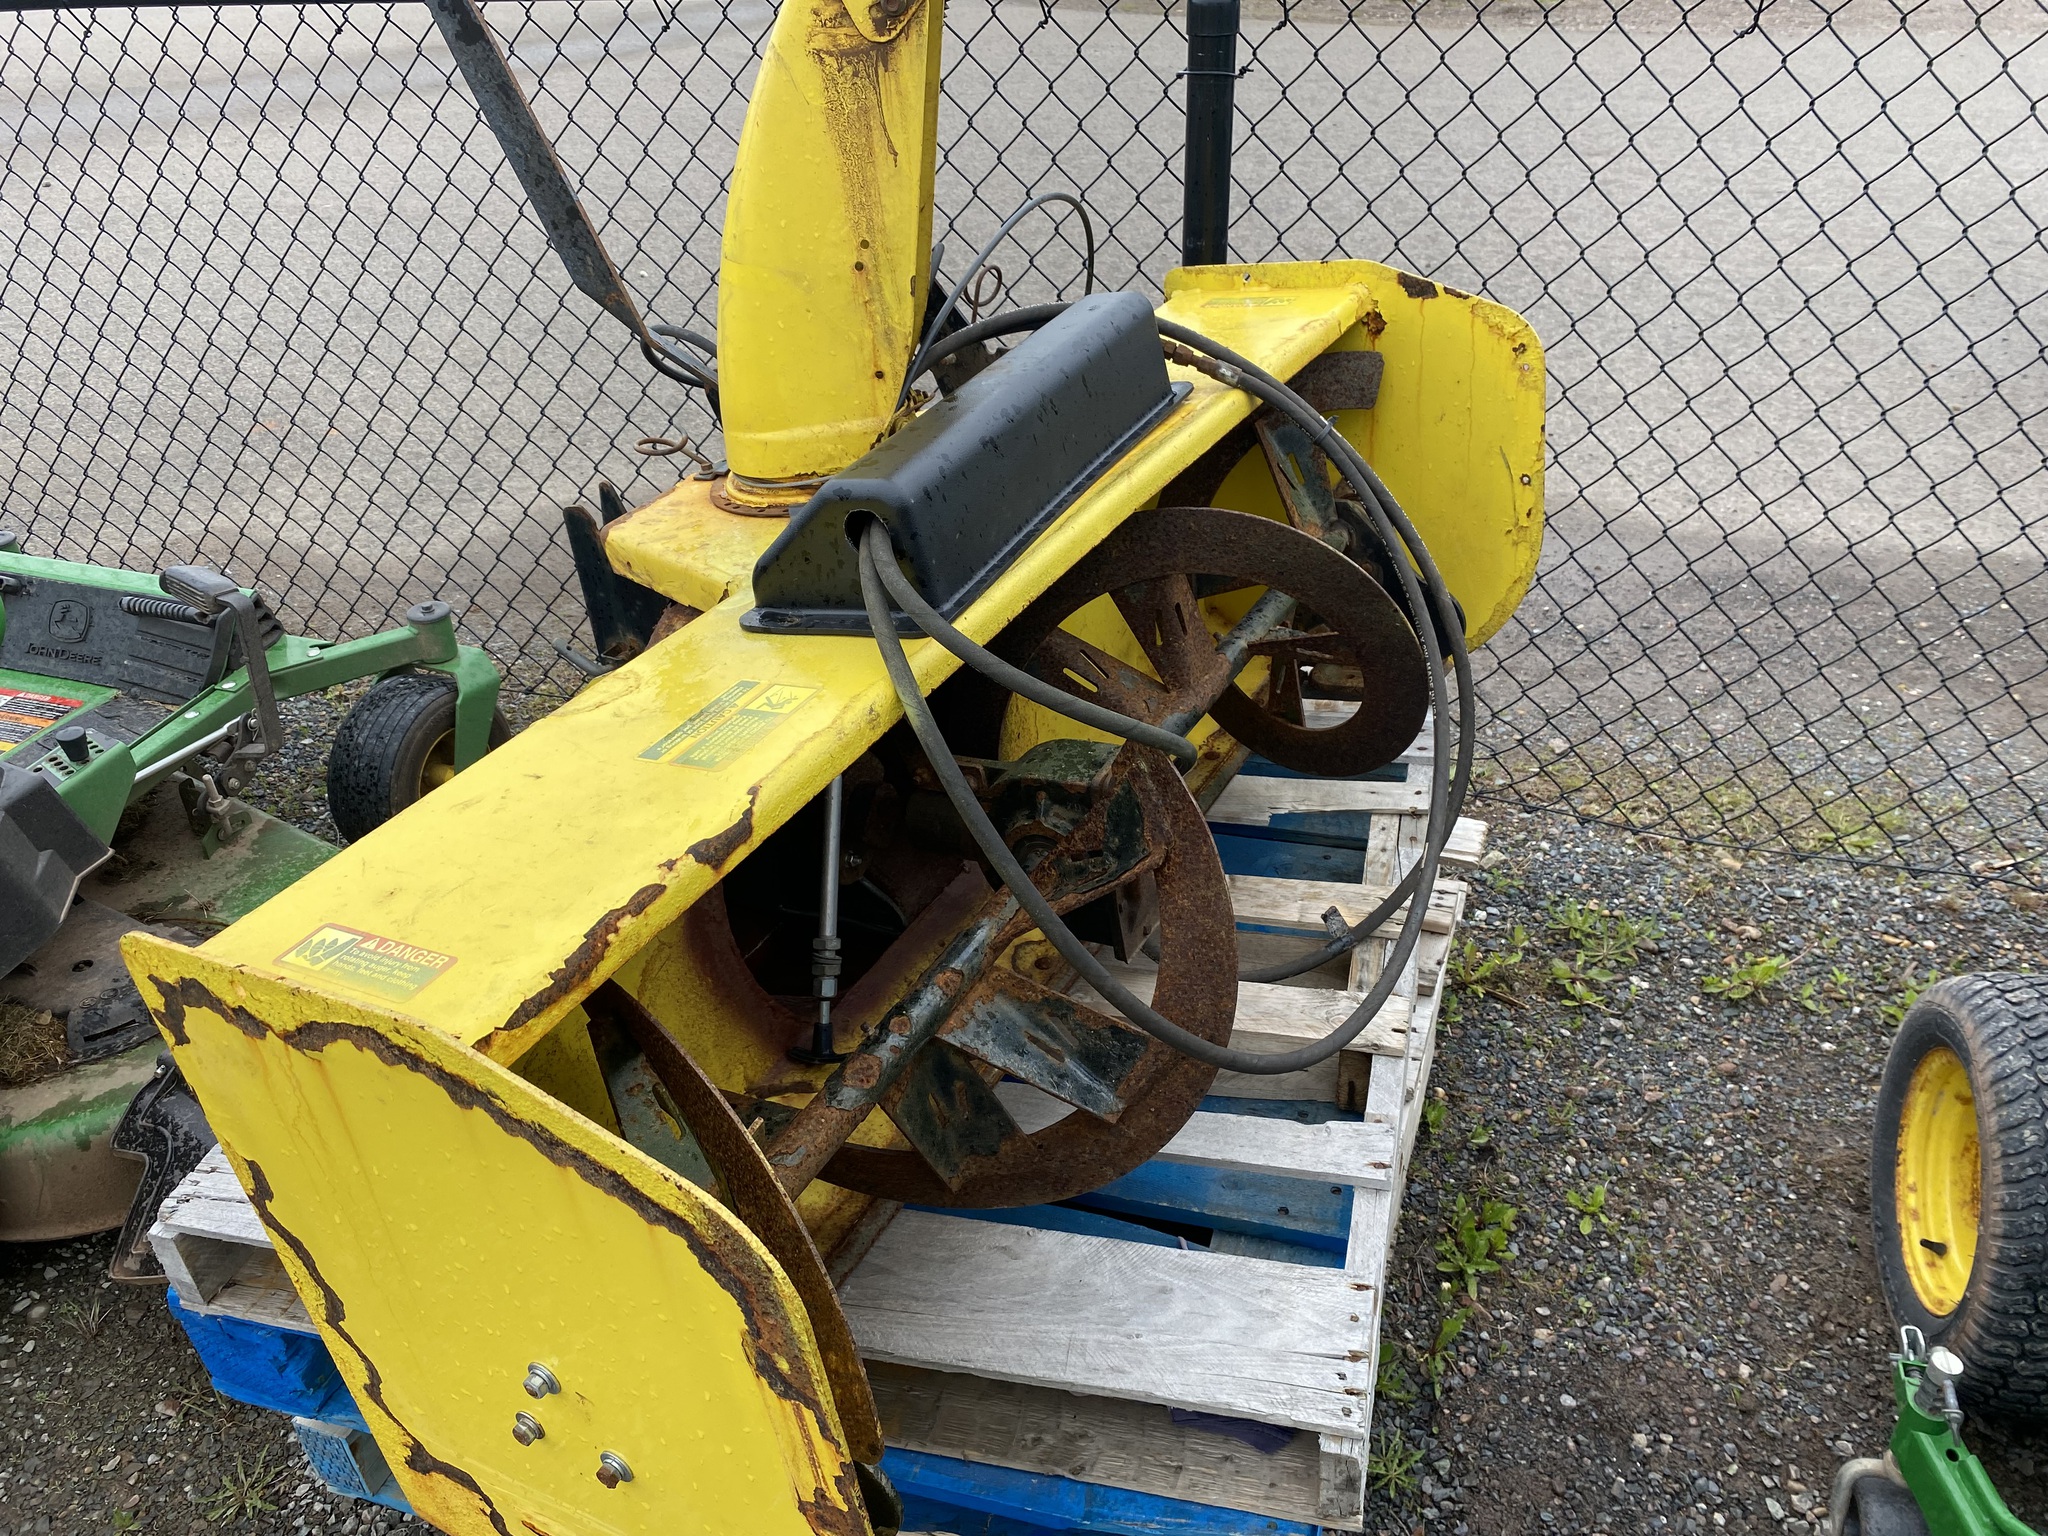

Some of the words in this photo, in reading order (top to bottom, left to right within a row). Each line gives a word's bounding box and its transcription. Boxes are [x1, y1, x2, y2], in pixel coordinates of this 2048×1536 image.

[25, 643, 56, 659] JOHN
[59, 649, 103, 666] DEERE
[690, 709, 731, 738] CAUTION
[359, 951, 381, 961] avoid
[380, 956, 401, 968] injury
[401, 963, 420, 972] from
[377, 941, 450, 967] DANGER
[340, 955, 369, 968] rotating
[391, 969, 411, 979] keep
[357, 968, 373, 976] feet
[371, 972, 389, 980] and
[386, 977, 418, 990] clothing
